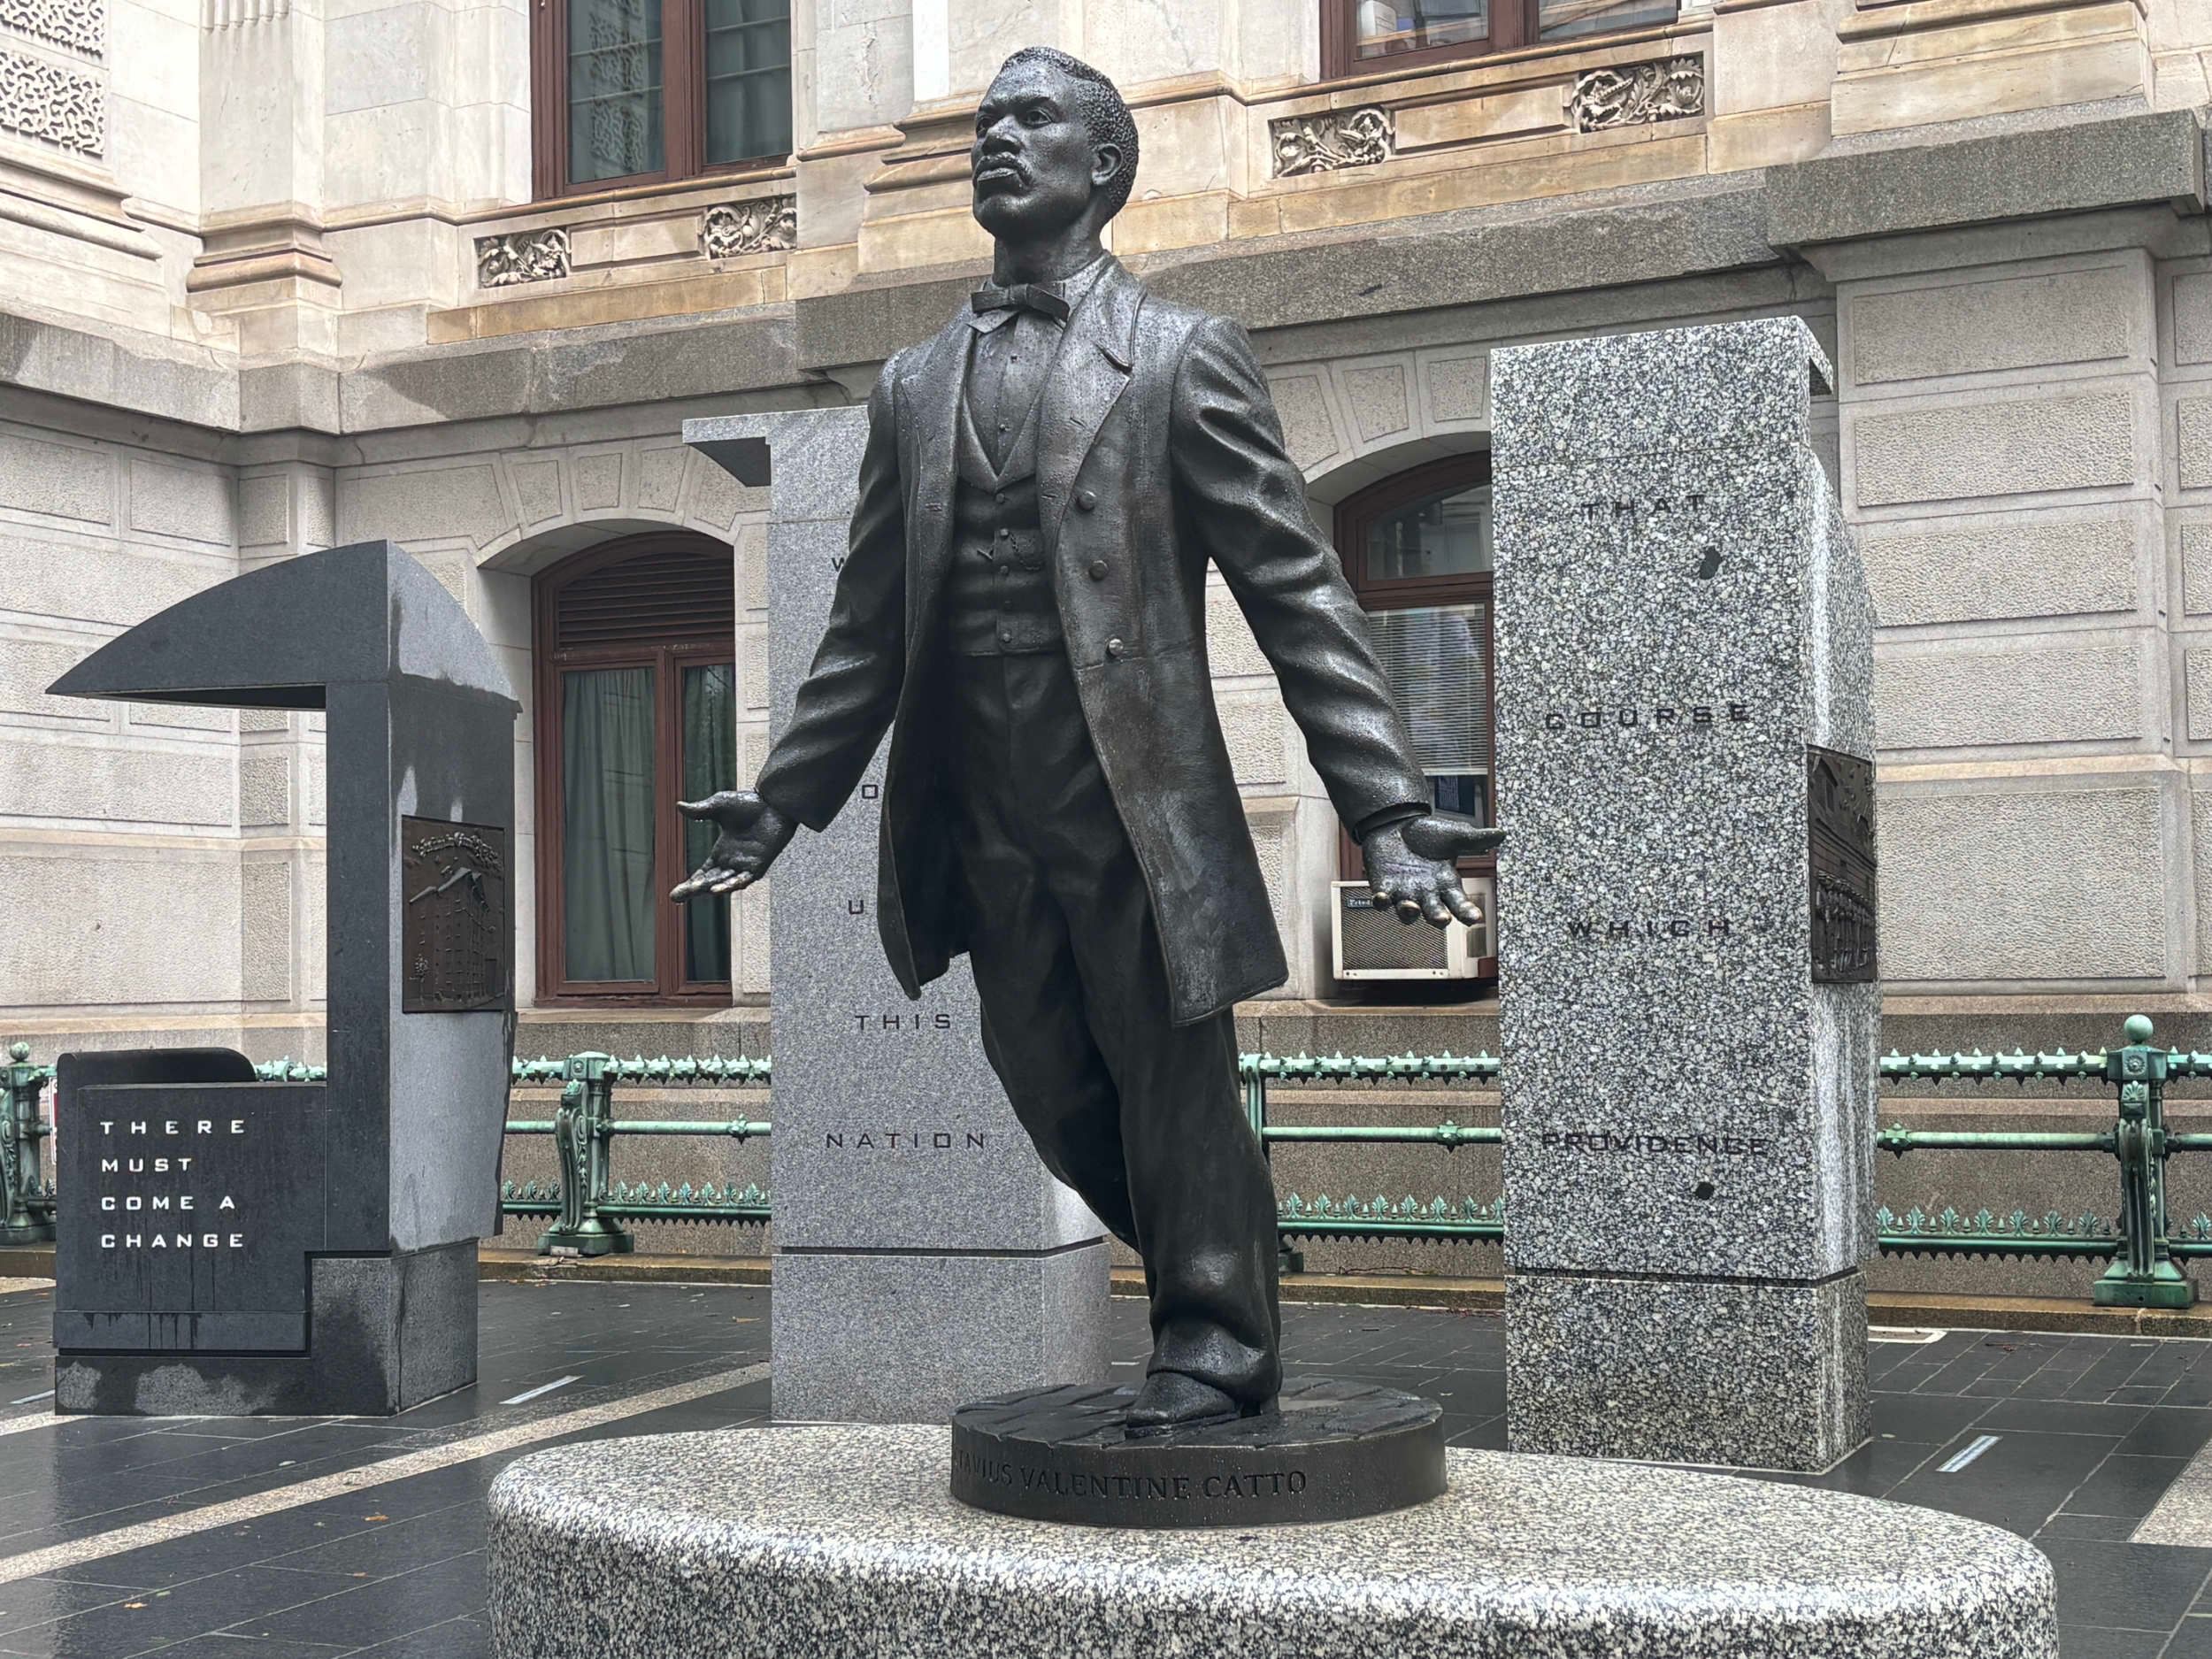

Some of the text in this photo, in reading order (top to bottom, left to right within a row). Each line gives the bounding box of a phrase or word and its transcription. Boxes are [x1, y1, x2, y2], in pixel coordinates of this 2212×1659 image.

[1581, 495, 1704, 521] THAT
[1546, 704, 1749, 729] COURSE
[1568, 920, 1729, 937] WHICH
[855, 1014, 950, 1030] THIS
[100, 1120, 244, 1134] THERE
[826, 1133, 984, 1149] NATION
[1542, 1132, 1770, 1155] PROVIDENCE
[102, 1158, 192, 1172] MUST
[102, 1196, 235, 1210] COME A
[102, 1234, 243, 1248] CHANGE
[954, 1448, 1306, 1501] TAVIUS VALENTINE CATTO
